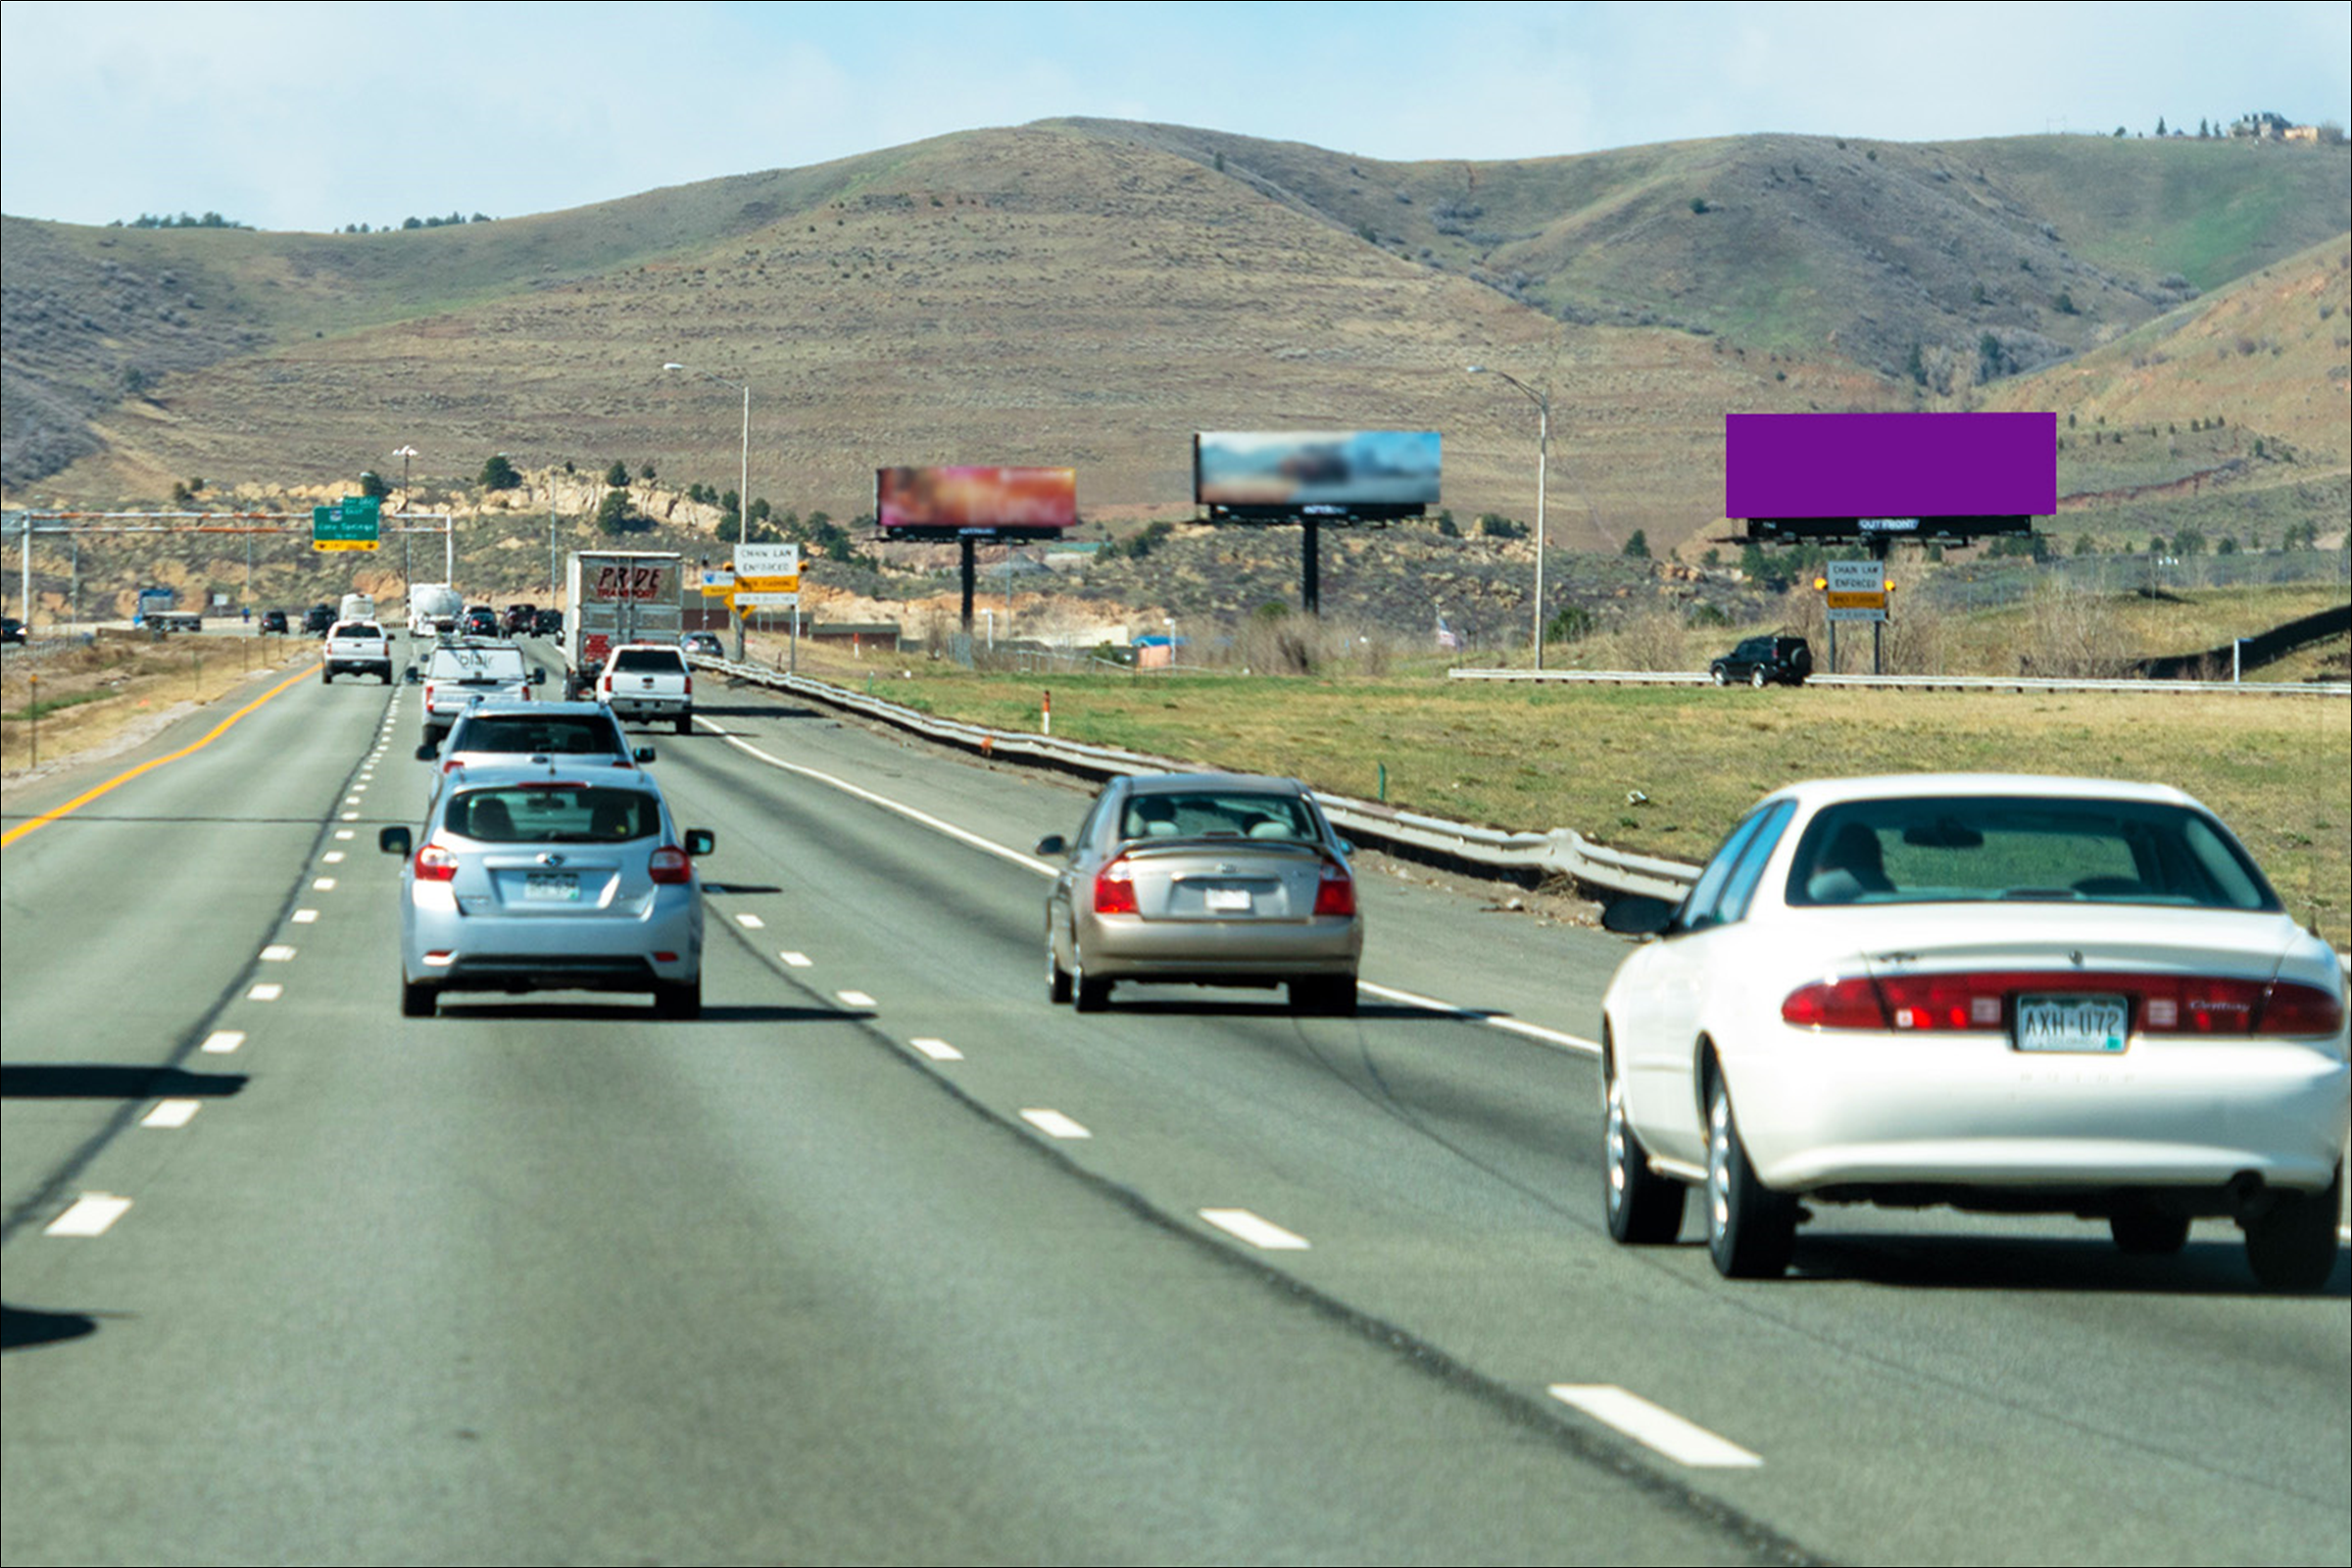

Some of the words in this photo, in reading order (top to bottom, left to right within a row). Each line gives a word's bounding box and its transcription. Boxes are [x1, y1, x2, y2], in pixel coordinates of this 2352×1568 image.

[1860, 518, 1917, 529] OUTFRONT
[1833, 564, 1858, 574] CHAIN
[598, 566, 661, 589] PRDE
[1835, 578, 1878, 588] ENFORCED
